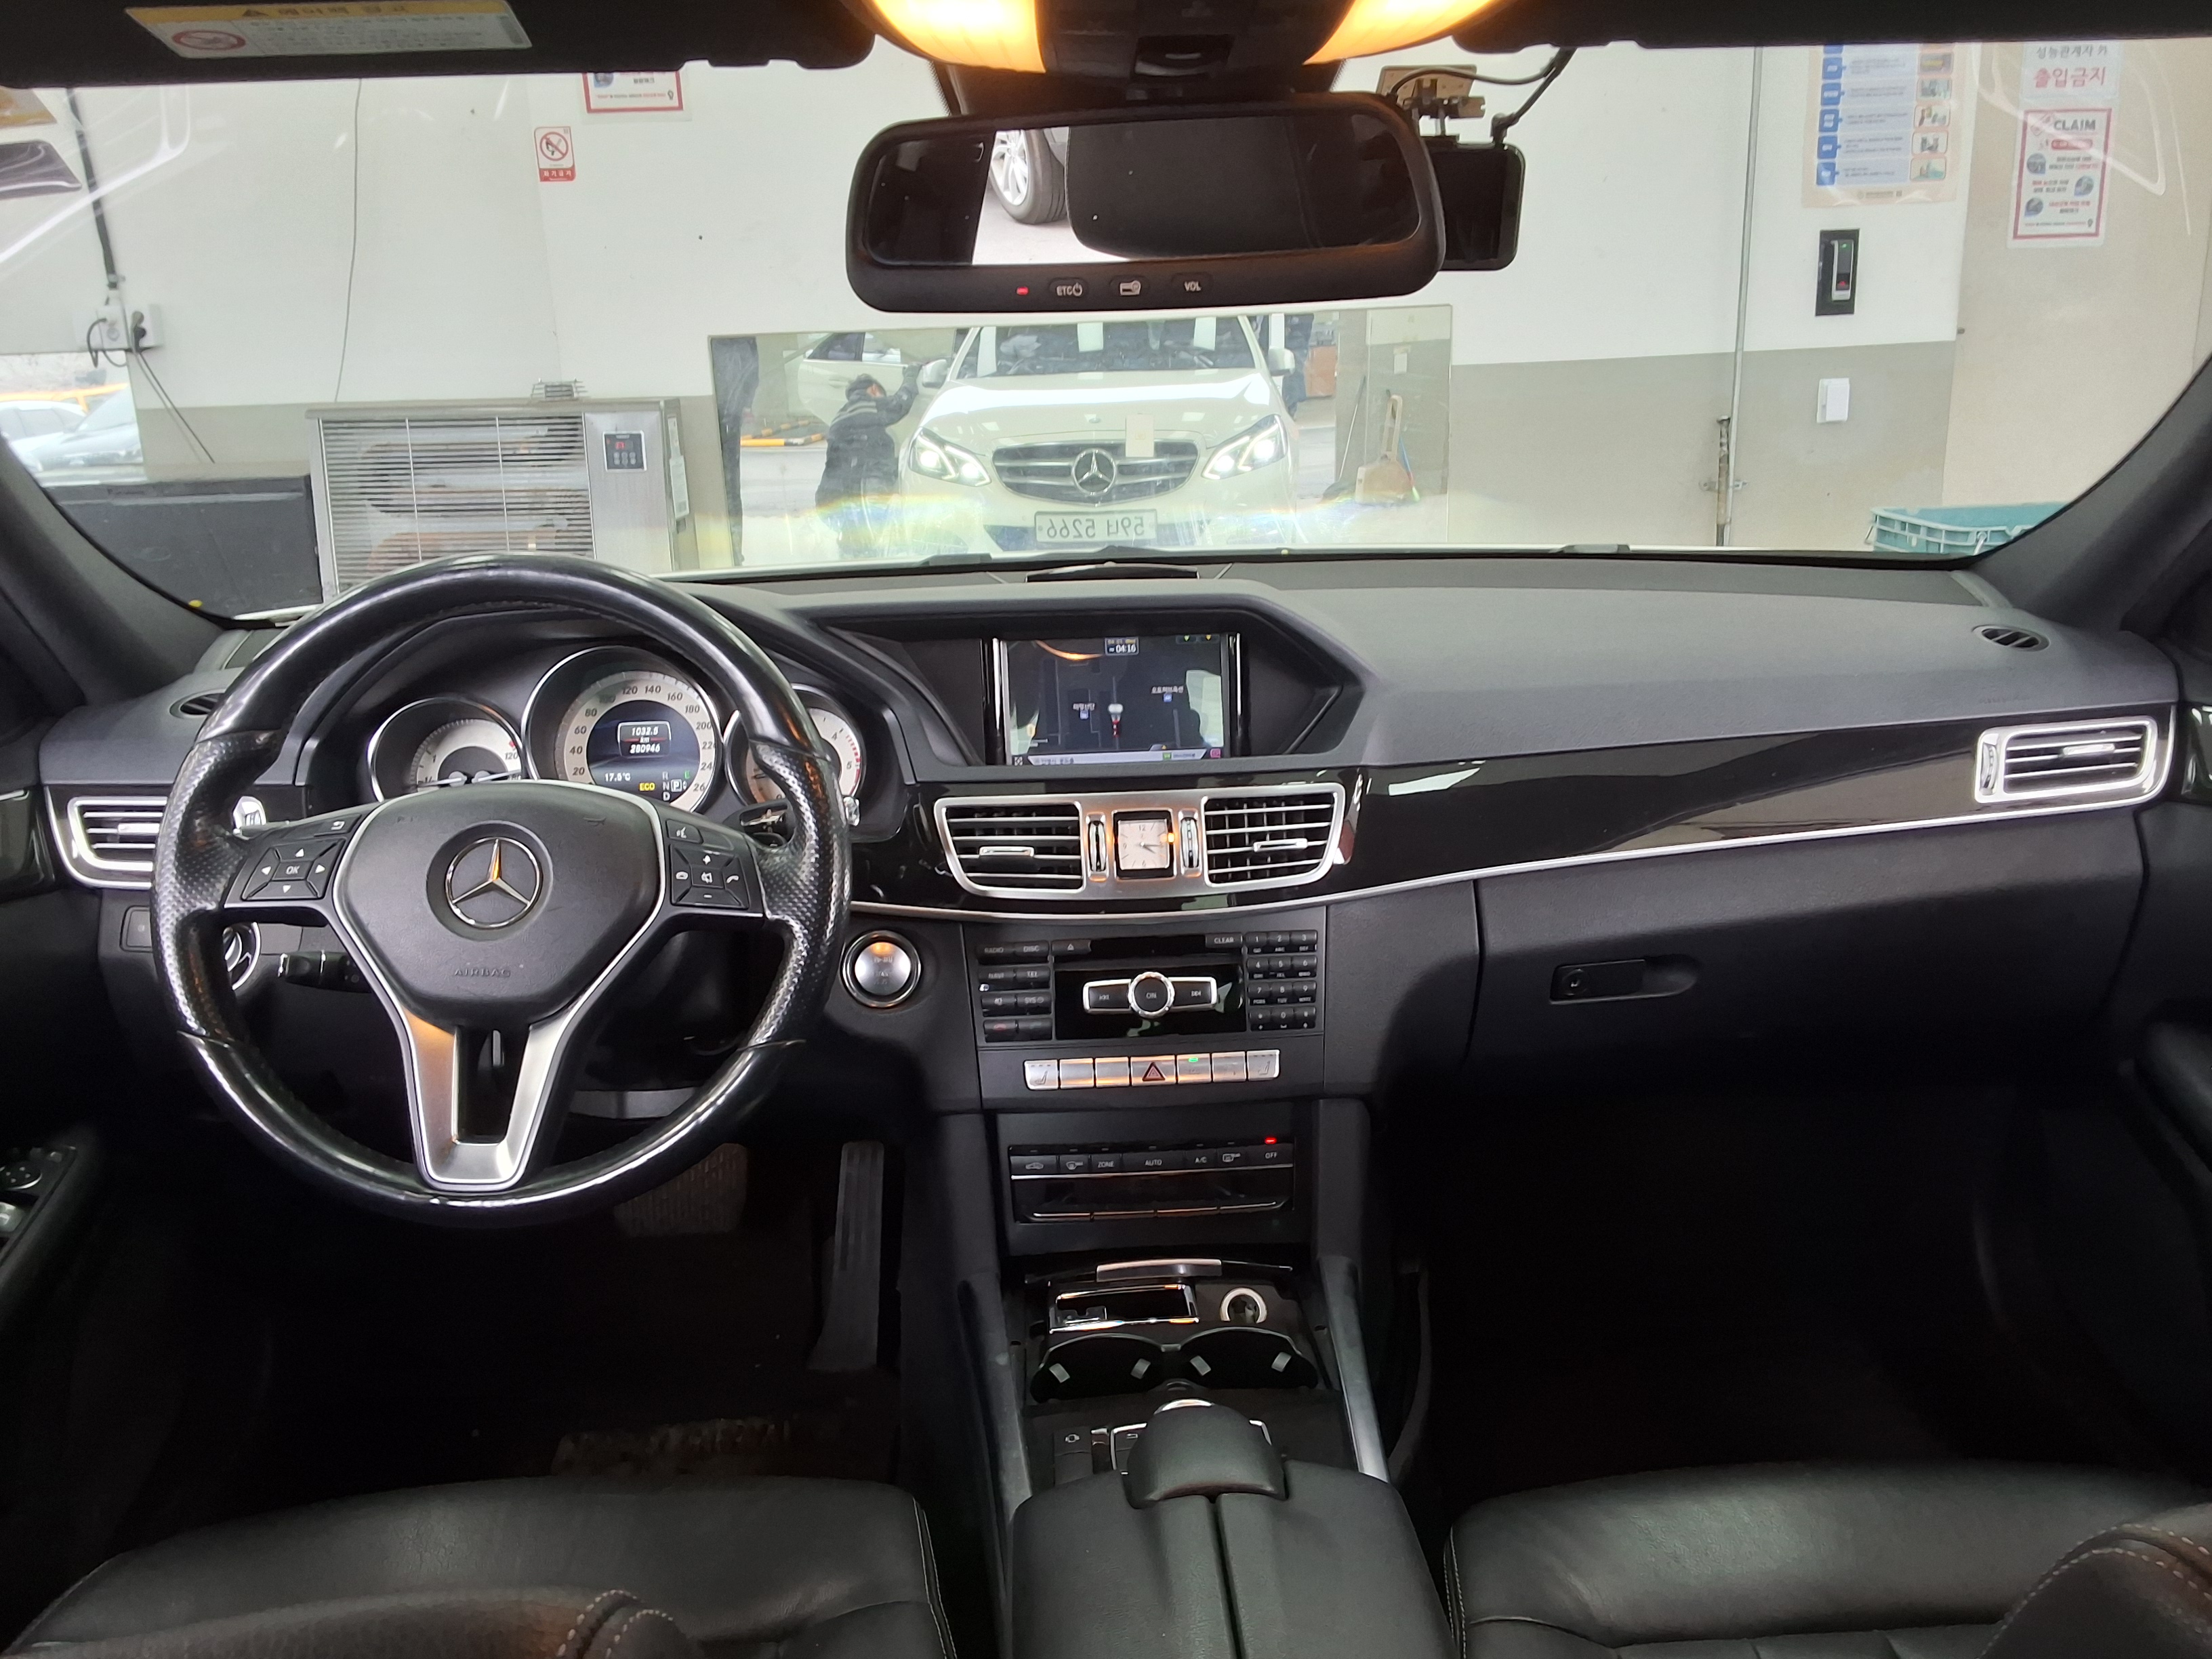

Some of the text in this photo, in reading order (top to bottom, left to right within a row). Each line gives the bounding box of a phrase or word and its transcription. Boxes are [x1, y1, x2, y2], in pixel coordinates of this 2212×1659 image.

[2034, 66, 2106, 88] 출입금지
[2053, 119, 2096, 131] CLAIM
[1056, 285, 1073, 296] ETC
[1184, 281, 1202, 292] VOL
[622, 685, 638, 695] 120
[644, 684, 661, 694] 140
[667, 693, 683, 701] 160
[585, 708, 598, 717] 80
[684, 705, 700, 714] 180
[574, 726, 587, 735] 60
[695, 722, 712, 730] 200
[701, 741, 716, 750] 22
[569, 746, 583, 755] 40
[572, 766, 585, 776] 20
[639, 783, 655, 792] ECO
[662, 781, 670, 791] N
[663, 792, 671, 801] D
[285, 865, 300, 875] OK
[1214, 936, 1234, 944] CLEAR
[1023, 945, 1040, 953] DISC
[1024, 996, 1037, 1004] SYS
[1265, 1151, 1277, 1160] OFF
